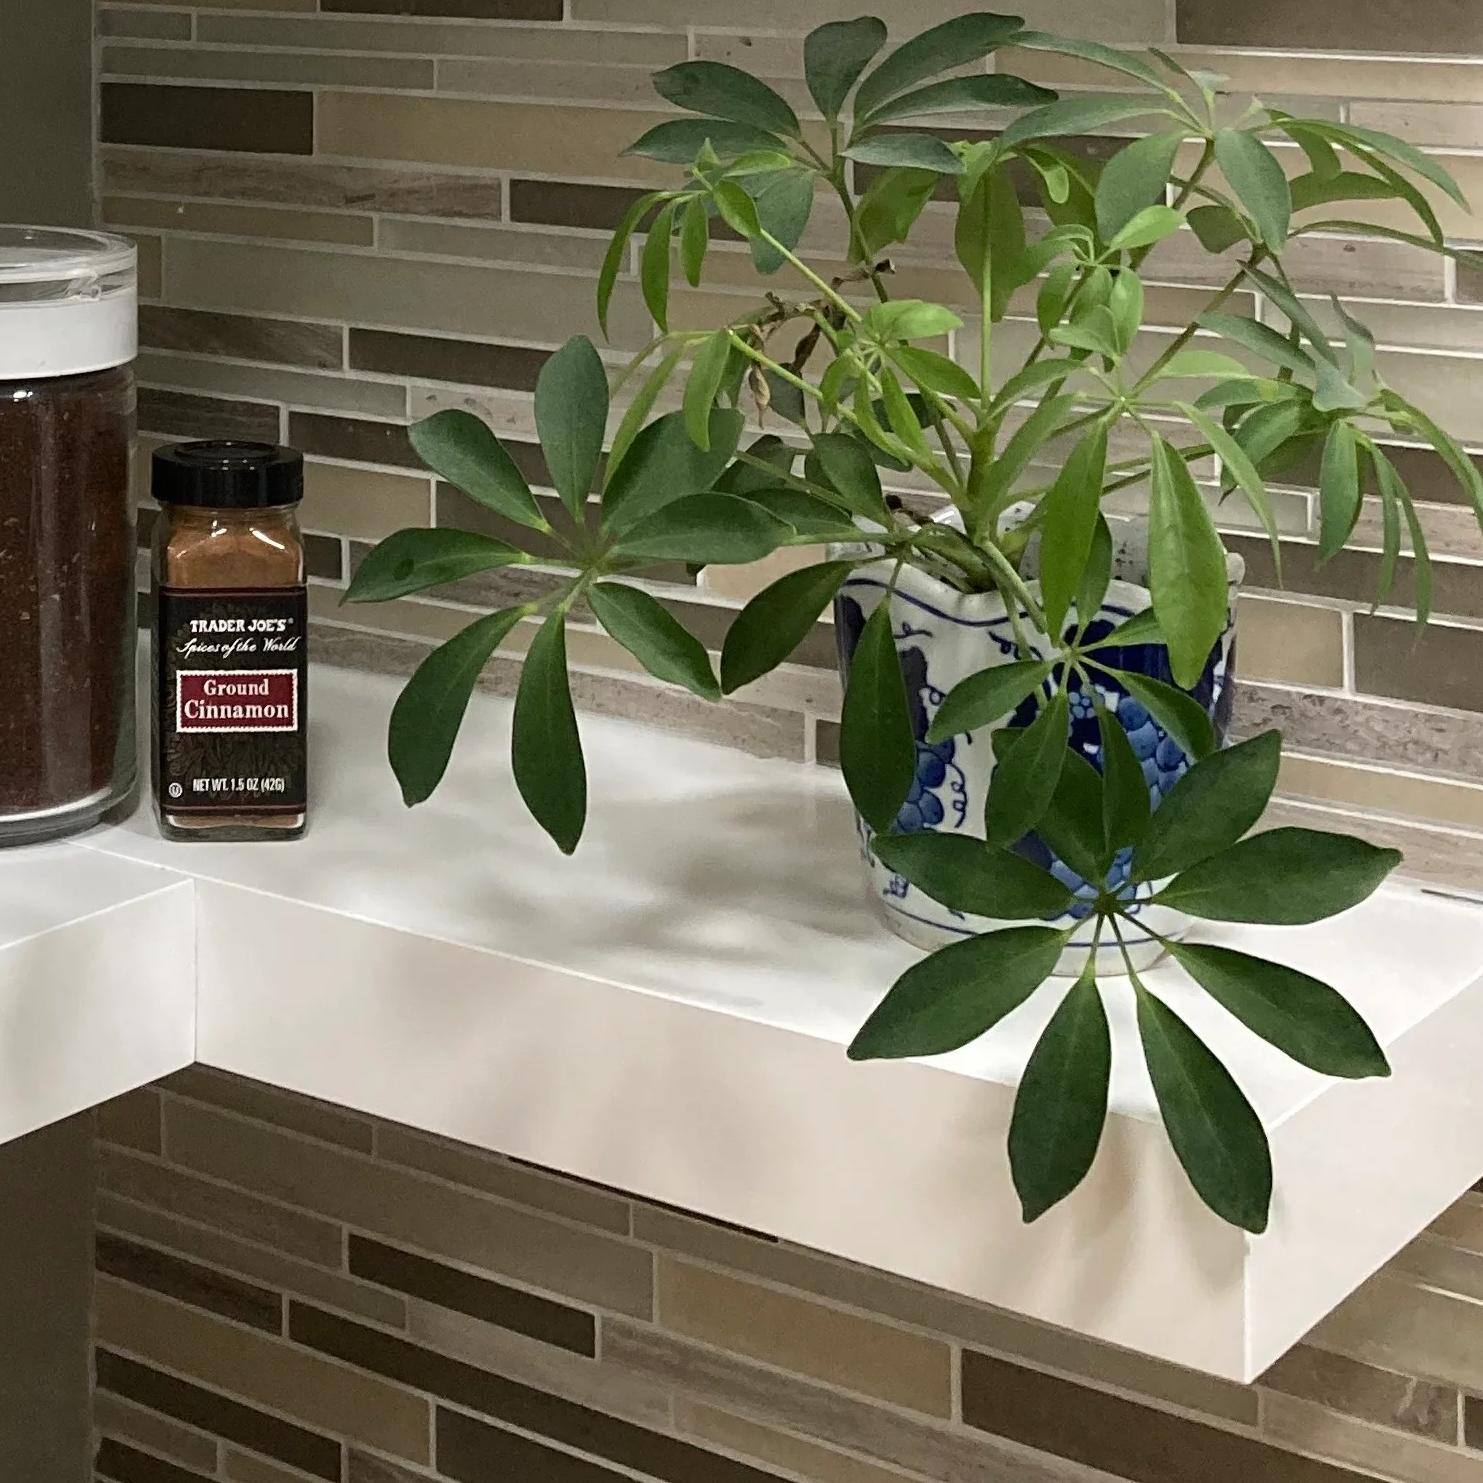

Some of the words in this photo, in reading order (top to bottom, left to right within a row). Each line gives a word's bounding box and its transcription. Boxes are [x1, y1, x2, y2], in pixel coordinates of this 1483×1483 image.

[190, 619, 246, 633] TRADER
[247, 618, 287, 632] JOE'S
[177, 637, 221, 659] Spices
[221, 637, 242, 659] of
[236, 637, 258, 652] the
[263, 636, 302, 652] World
[203, 678, 270, 696] Ground
[184, 699, 289, 719] Cinnamon
[192, 778, 210, 792] NET
[211, 778, 229, 792] WT.
[230, 778, 245, 791] 1.5
[246, 778, 259, 791] OZ
[260, 778, 285, 793] (42G)
